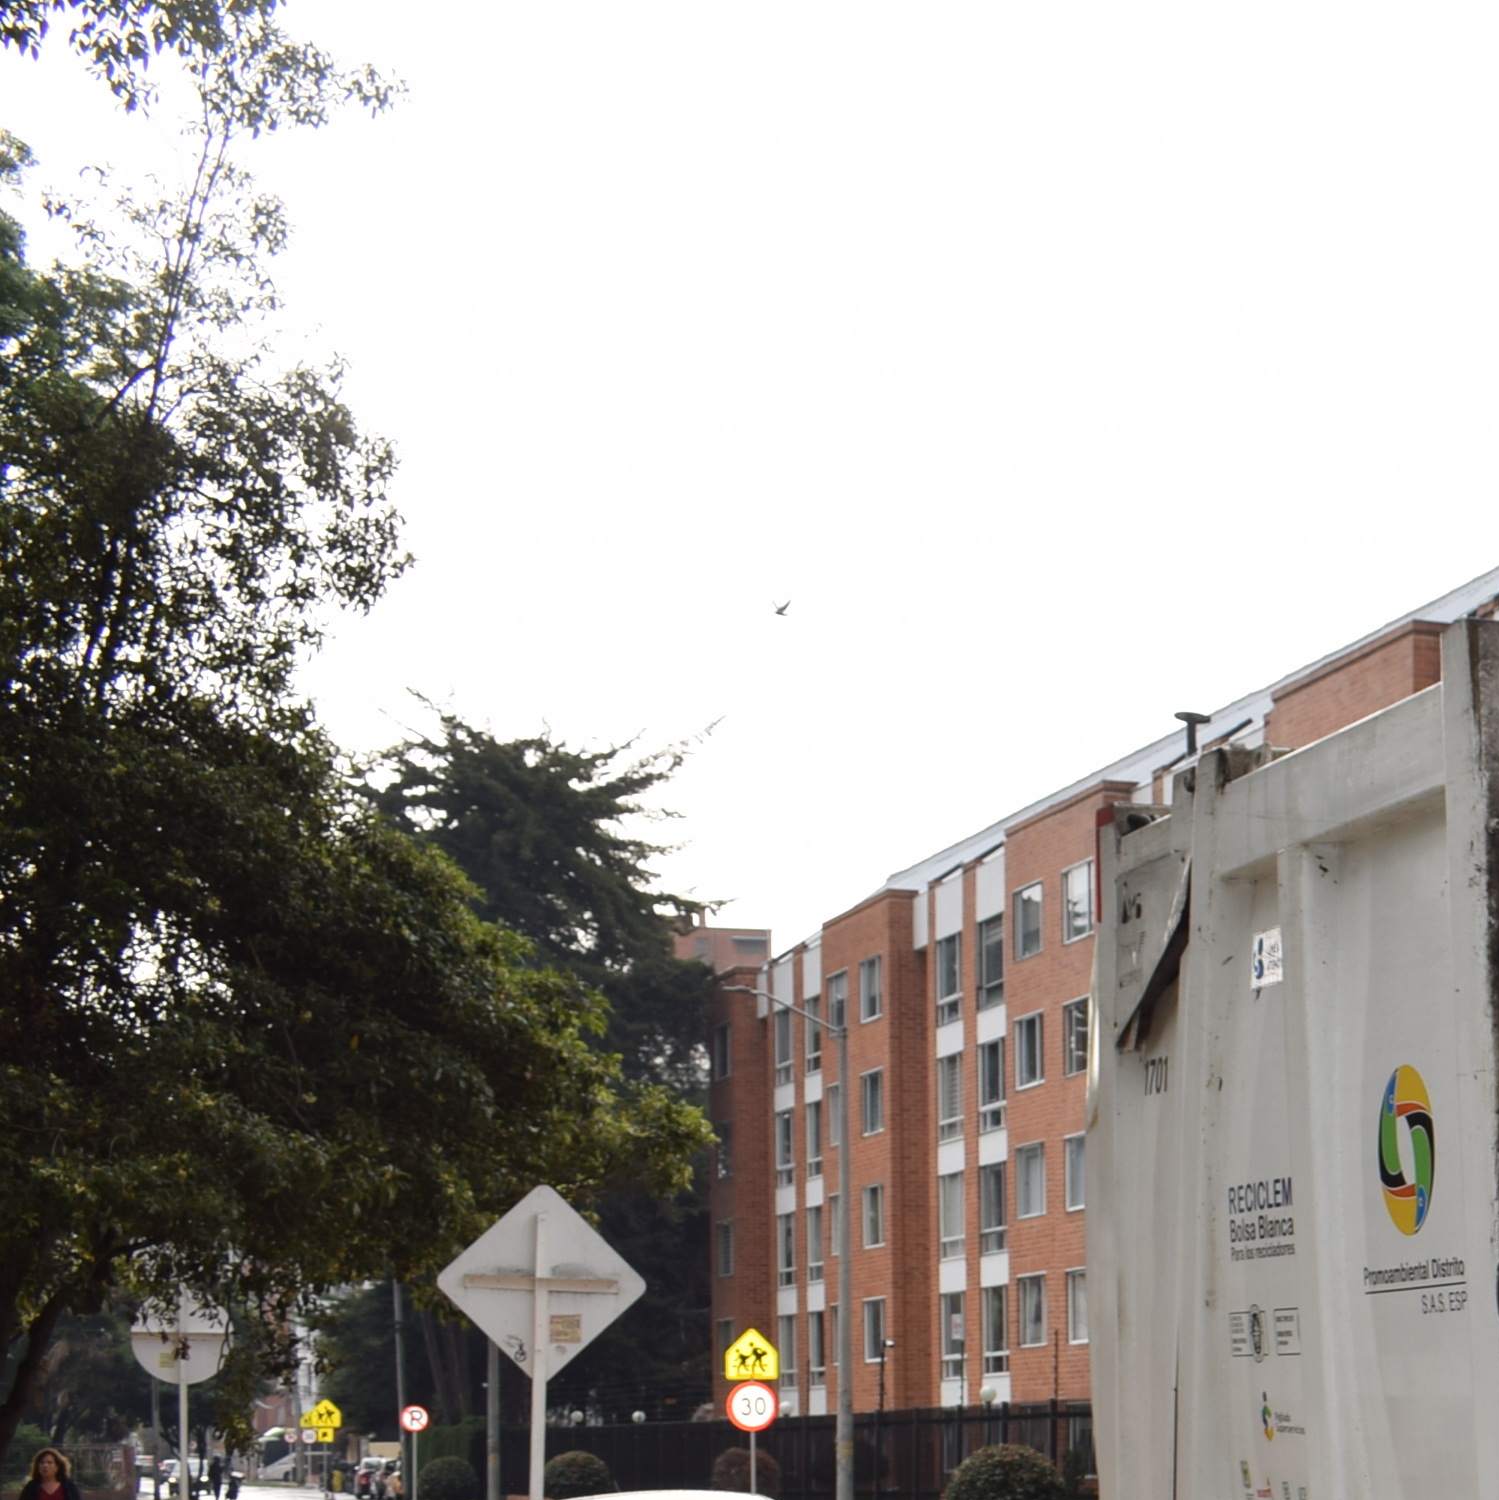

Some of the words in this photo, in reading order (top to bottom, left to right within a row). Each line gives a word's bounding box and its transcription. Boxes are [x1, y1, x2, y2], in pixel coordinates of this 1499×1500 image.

[1144, 1056, 1169, 1096] 1701
[1228, 1177, 1293, 1215] RECICLEM
[1229, 1218, 1257, 1243] Bolsa
[1257, 1215, 1295, 1240] Blanca
[1363, 1260, 1430, 1286] Promoambiental
[1431, 1257, 1465, 1278] Distrito
[1449, 1291, 1468, 1311] ESP
[741, 1397, 766, 1416] 30
